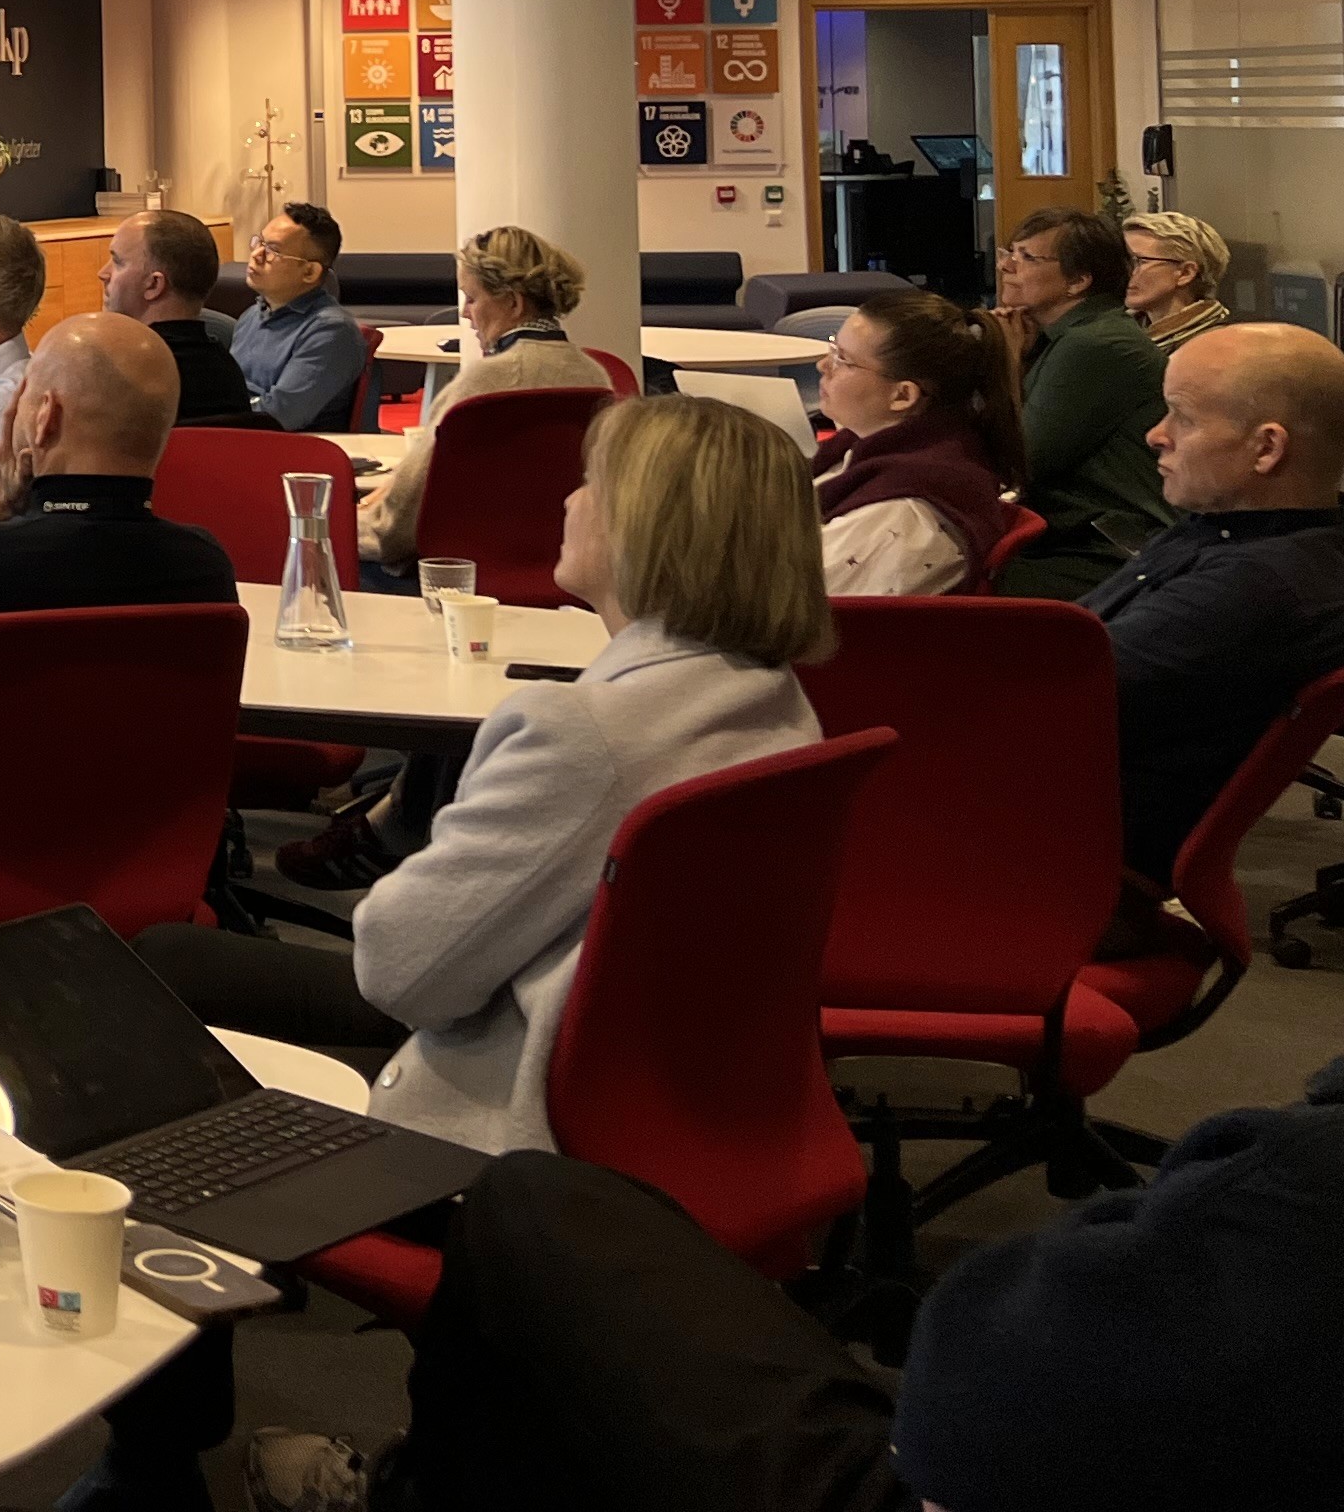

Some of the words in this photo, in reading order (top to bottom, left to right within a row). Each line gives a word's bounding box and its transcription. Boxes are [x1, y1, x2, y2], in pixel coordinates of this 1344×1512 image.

[640, 36, 652, 49] 11
[716, 34, 728, 48] 12
[349, 108, 363, 123] 13
[422, 108, 436, 123] 14
[644, 105, 656, 121] 17
